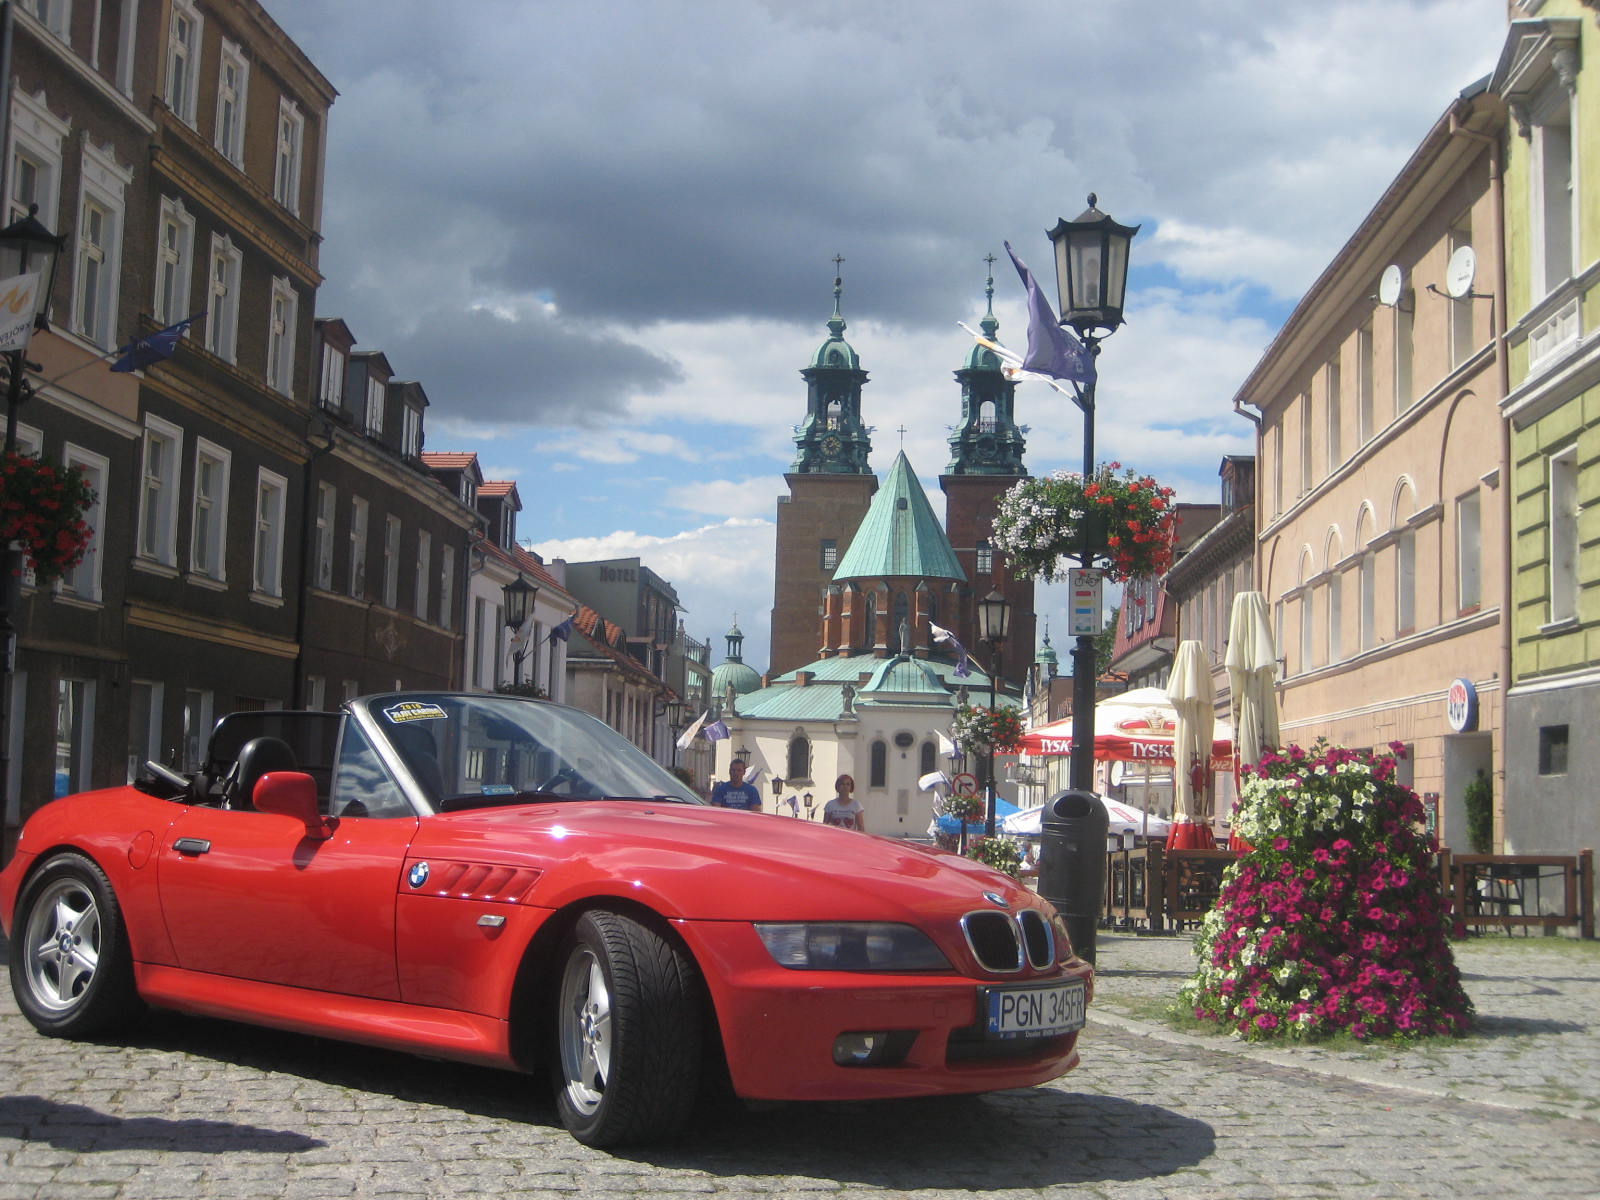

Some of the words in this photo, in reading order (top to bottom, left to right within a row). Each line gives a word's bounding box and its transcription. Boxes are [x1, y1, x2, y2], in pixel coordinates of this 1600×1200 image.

[600, 566, 637, 582] HOTEL
[1040, 738, 1073, 754] TYSK
[1001, 993, 1043, 1028] PGN
[1049, 988, 1083, 1024] 345FR
[989, 1017, 998, 1026] PL
